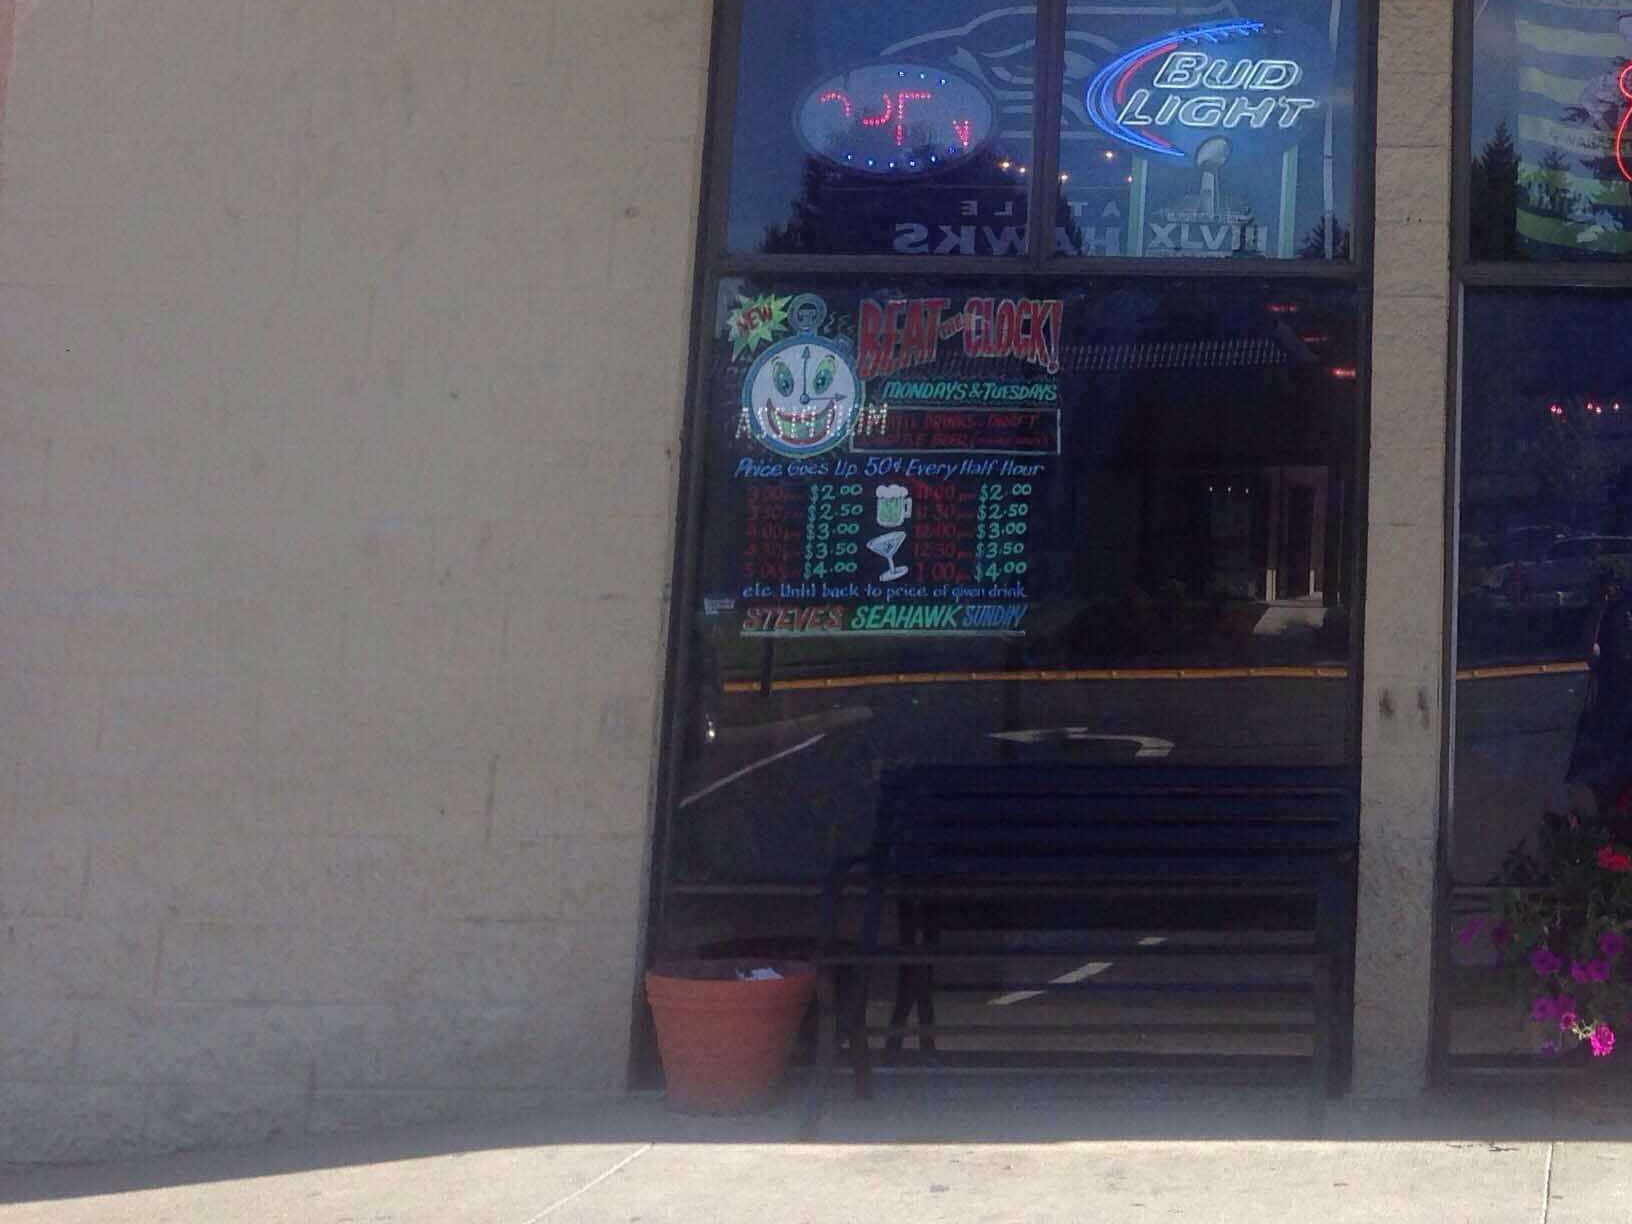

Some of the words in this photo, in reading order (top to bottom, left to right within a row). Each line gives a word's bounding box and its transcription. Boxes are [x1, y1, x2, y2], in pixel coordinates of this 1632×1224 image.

[1153, 52, 1302, 89] BUD
[1116, 91, 1314, 127] LIGHT
[736, 307, 773, 331] NEW
[857, 299, 948, 375] BEAT
[963, 297, 1063, 375] CLOCK!
[735, 458, 782, 476] Price
[905, 458, 954, 479] Every
[959, 458, 998, 476] Half
[1000, 460, 1044, 476] Hour
[808, 504, 863, 522] $2.50
[976, 503, 1028, 521] $2.50
[807, 523, 860, 541] $3.00
[976, 522, 1027, 540] $3.00
[805, 543, 857, 559] $3.50
[803, 561, 857, 580] $4.00
[822, 584, 857, 597] back
[864, 584, 882, 597] to
[988, 582, 1027, 598] drink
[851, 604, 965, 628] SEAHAWK
[963, 604, 1029, 627] SUNDAY
